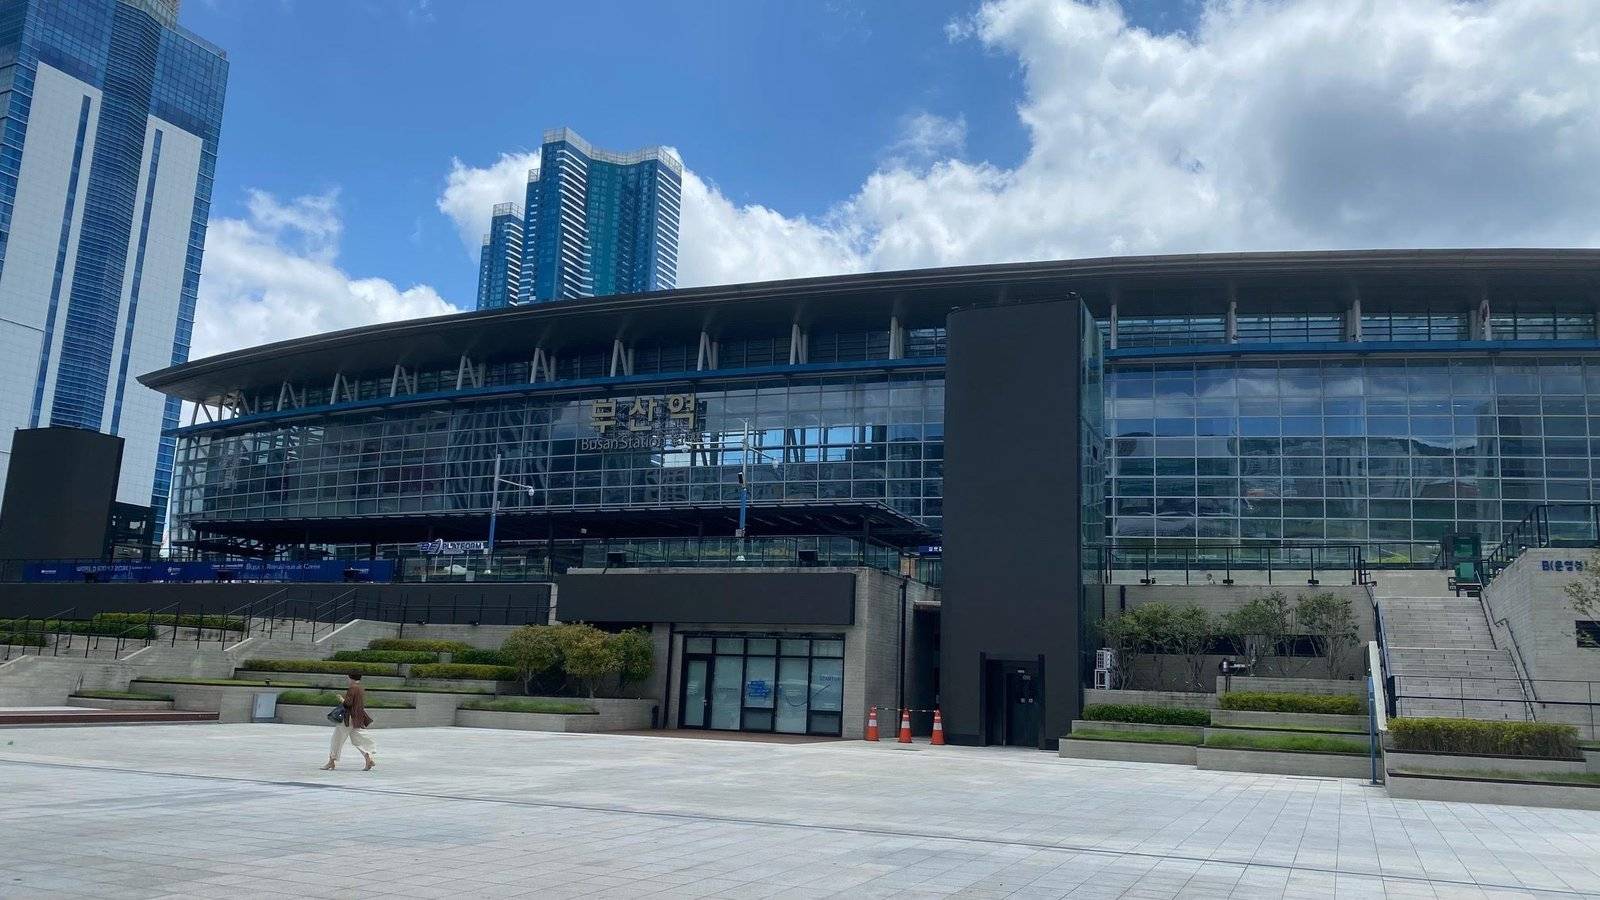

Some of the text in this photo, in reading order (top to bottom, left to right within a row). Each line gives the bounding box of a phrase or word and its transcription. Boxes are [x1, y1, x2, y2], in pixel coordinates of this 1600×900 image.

[590, 393, 696, 434] 부산역
[581, 438, 618, 451] Busan
[621, 435, 667, 449] Station
[443, 541, 483, 550] PLATFORM
